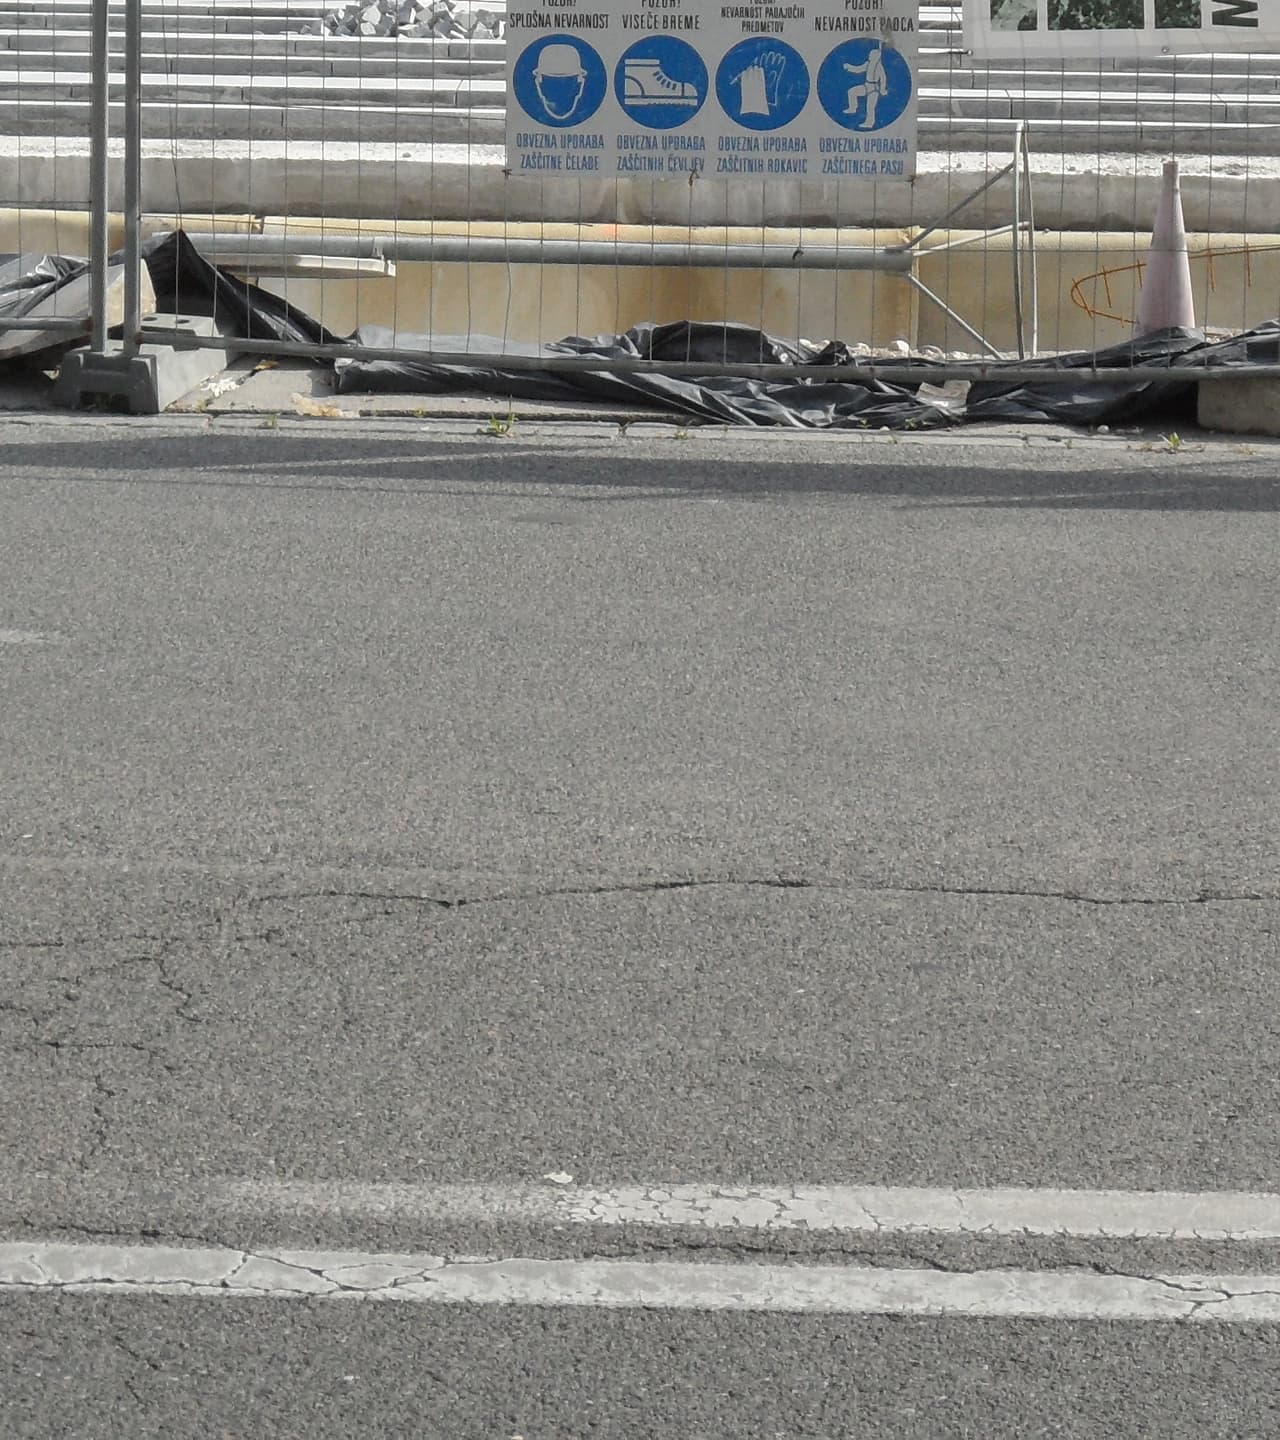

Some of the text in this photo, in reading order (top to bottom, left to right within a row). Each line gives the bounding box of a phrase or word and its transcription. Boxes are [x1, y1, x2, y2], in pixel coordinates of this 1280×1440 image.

[510, 10, 610, 29] SPLOŠNA NEVARNOST
[622, 12, 701, 30] VISEČE BREME
[721, 7, 763, 19] NEVARNOST
[814, 16, 877, 32] NEVARNOST
[516, 133, 604, 149] OBVEZNA UPORABA
[616, 135, 706, 150] OBVEZNA UPORABA
[718, 136, 807, 152] OBVEZNA UPORABA
[819, 137, 908, 153] OBVEZNA UPORABA
[521, 152, 562, 169] ZAŠČITNE
[616, 154, 664, 171] ZAŠČITNIH
[716, 155, 807, 173] ZAŠČITNIH ROKAVIC
[822, 156, 904, 175] ZAŠČITNEGA PASU
